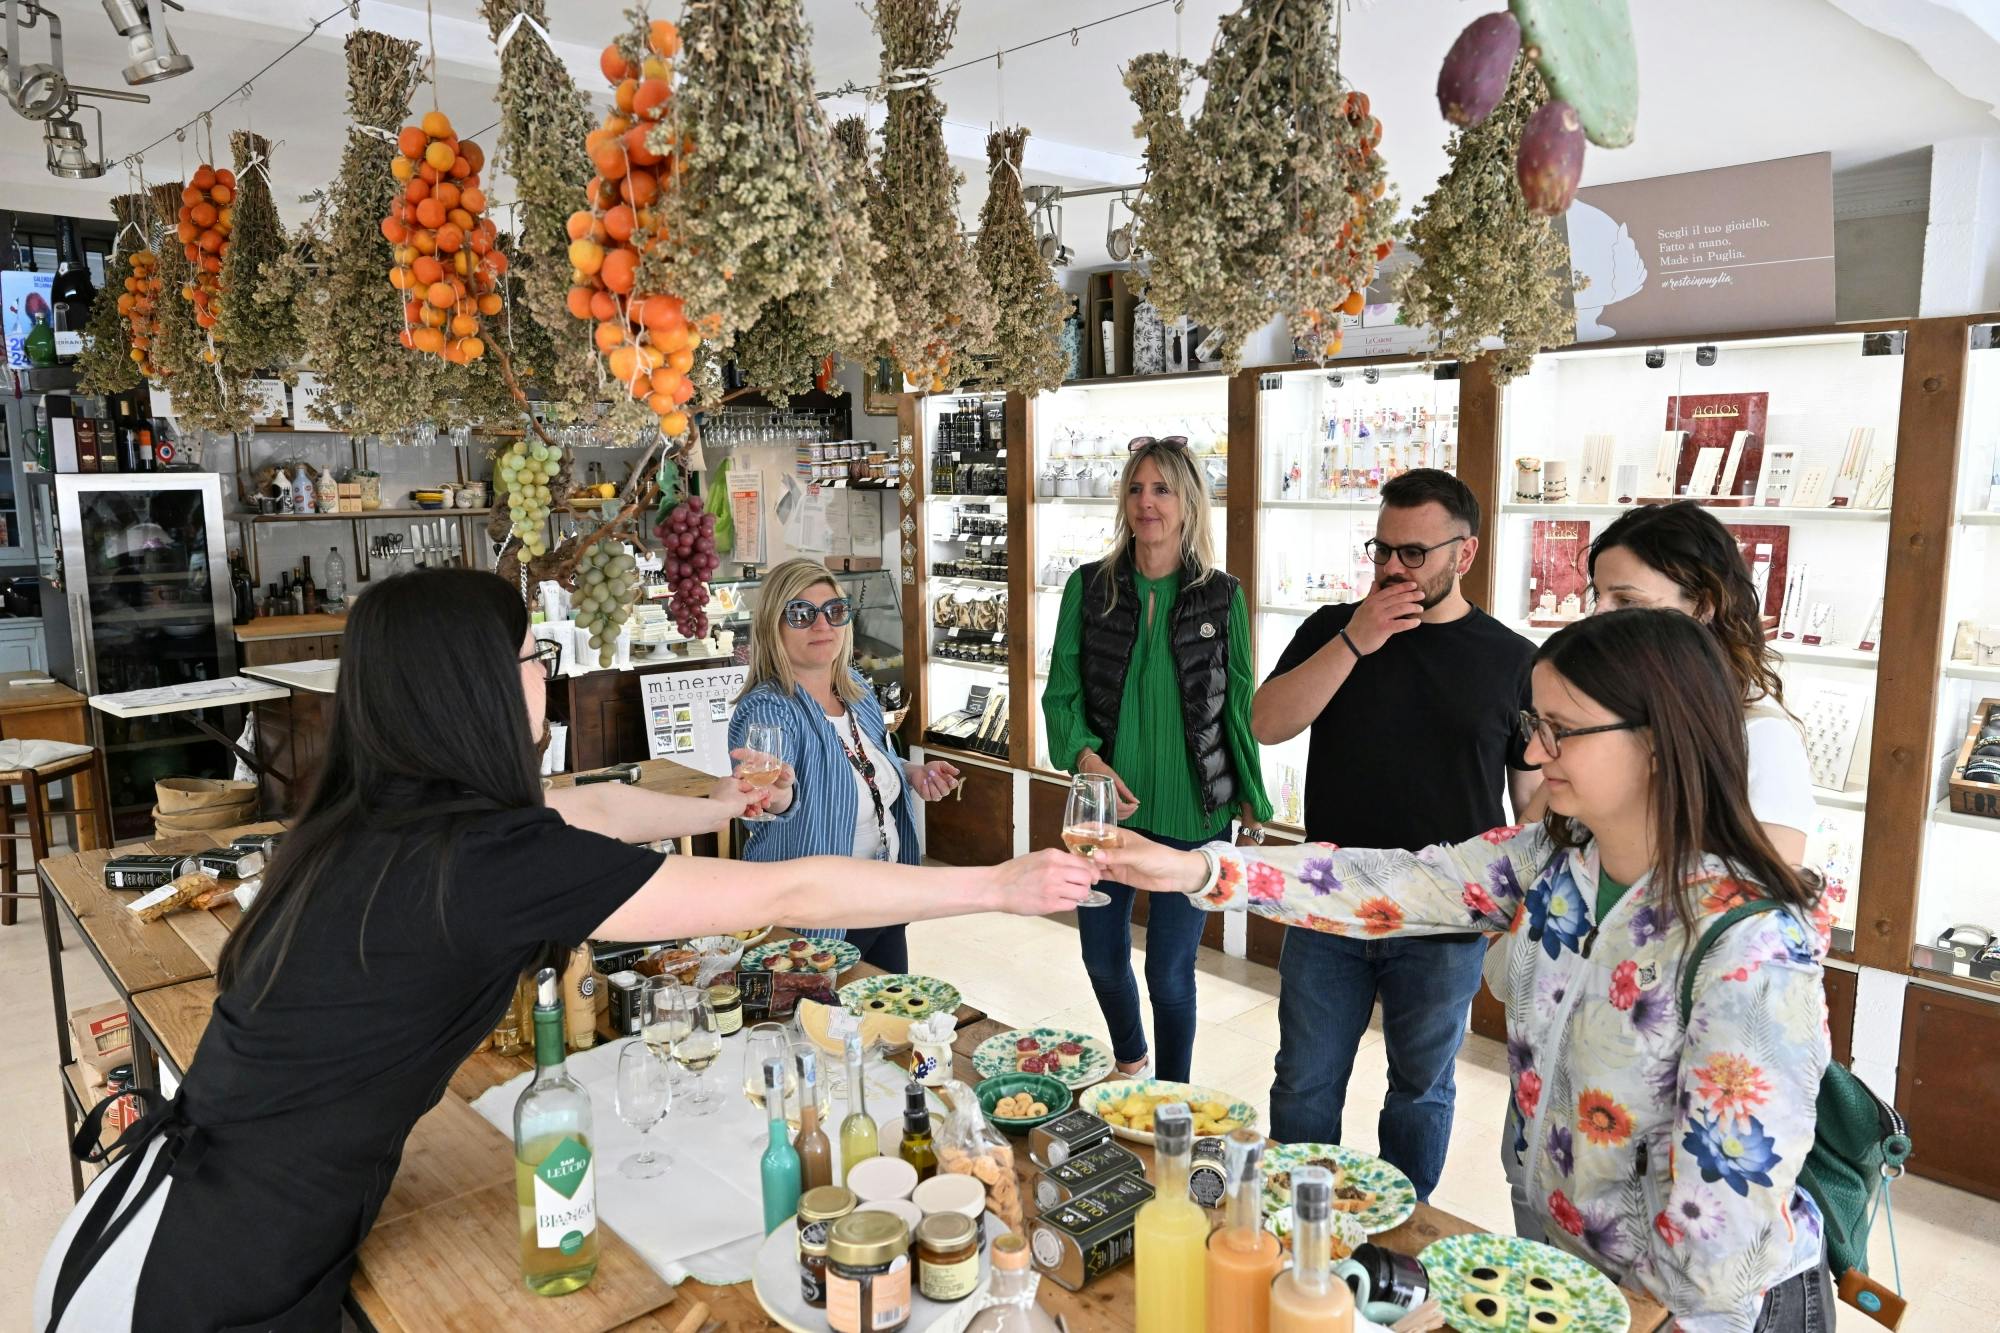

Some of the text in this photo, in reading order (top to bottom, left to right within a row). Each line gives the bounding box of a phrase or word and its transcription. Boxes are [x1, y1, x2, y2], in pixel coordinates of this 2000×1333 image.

[1658, 217, 1770, 239] Scegli il tuo gioiello.
[1660, 238, 1732, 253] Fatto a mano.
[1660, 248, 1745, 267] Made in Puglia.
[648, 673, 745, 693] minerva
[547, 1158, 587, 1179] LEUCIO
[560, 1156, 575, 1168] SAN
[540, 1199, 595, 1229] BIANCO
[1075, 1200, 1104, 1217] OLIO
